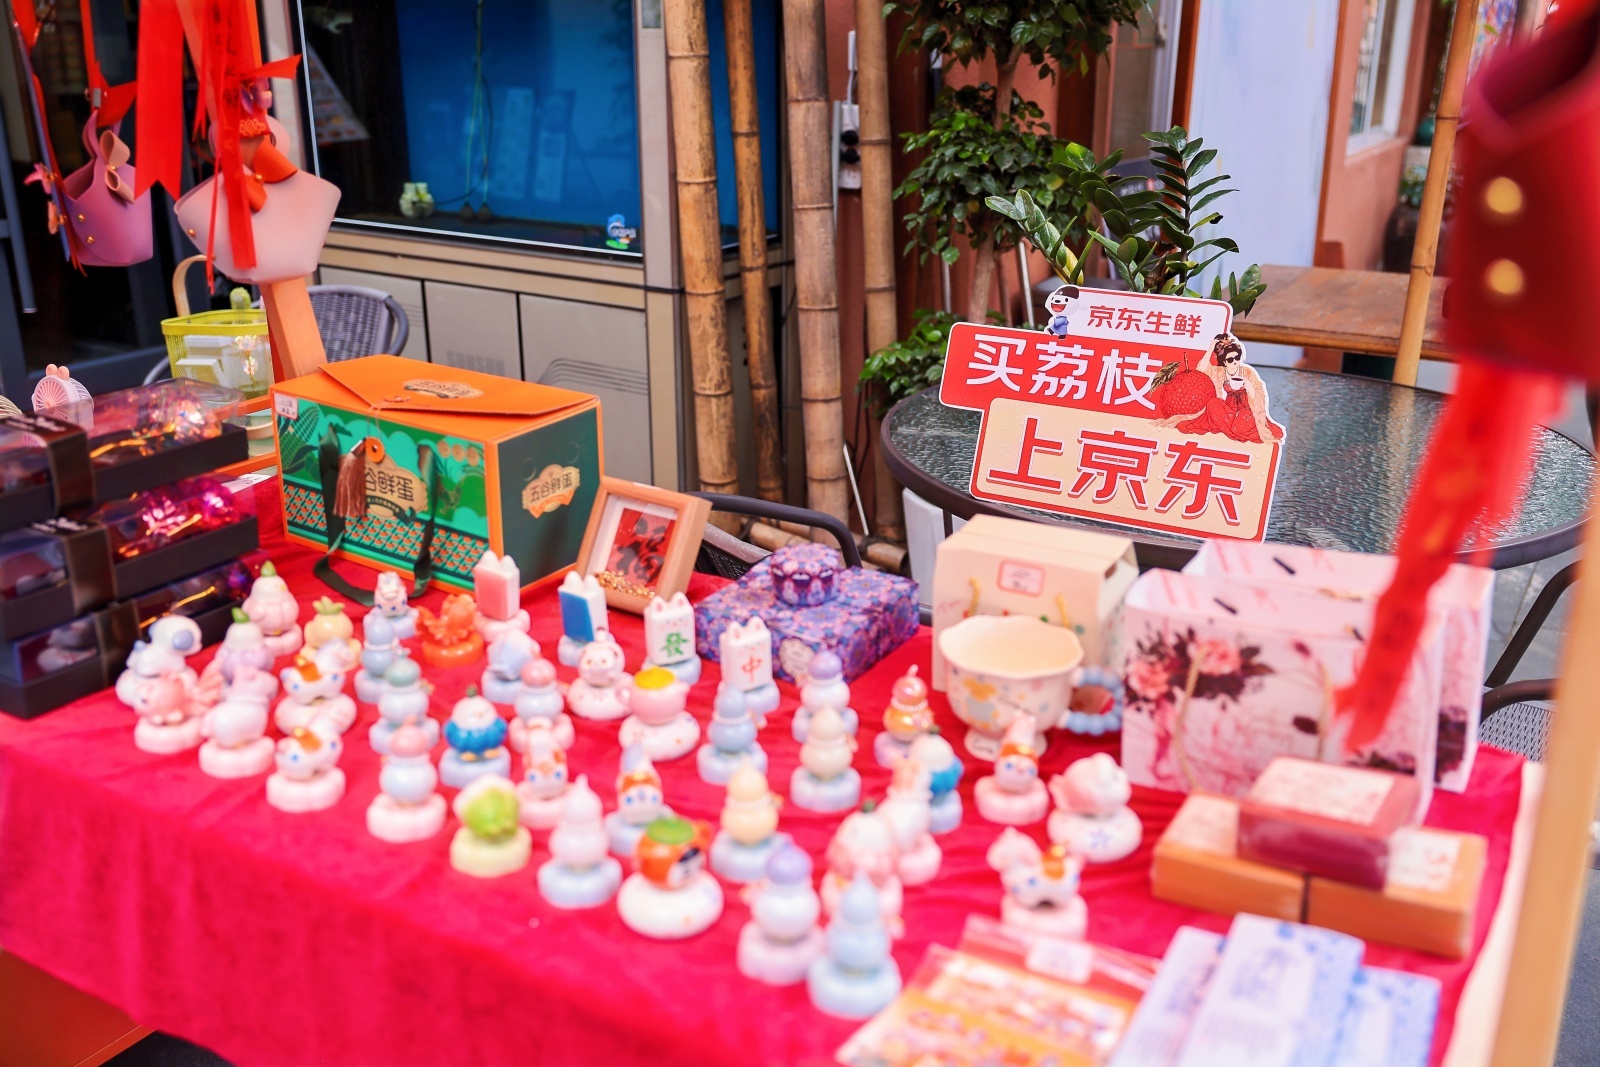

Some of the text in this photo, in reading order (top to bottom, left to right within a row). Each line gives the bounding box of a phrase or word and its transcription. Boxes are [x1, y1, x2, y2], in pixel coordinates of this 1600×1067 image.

[1087, 305, 1202, 339] 京东生鲜
[966, 333, 1163, 410] 买荔枝
[366, 467, 419, 503] 谷鲜蛋
[985, 417, 1252, 526] 上京东
[742, 656, 763, 683] 中
